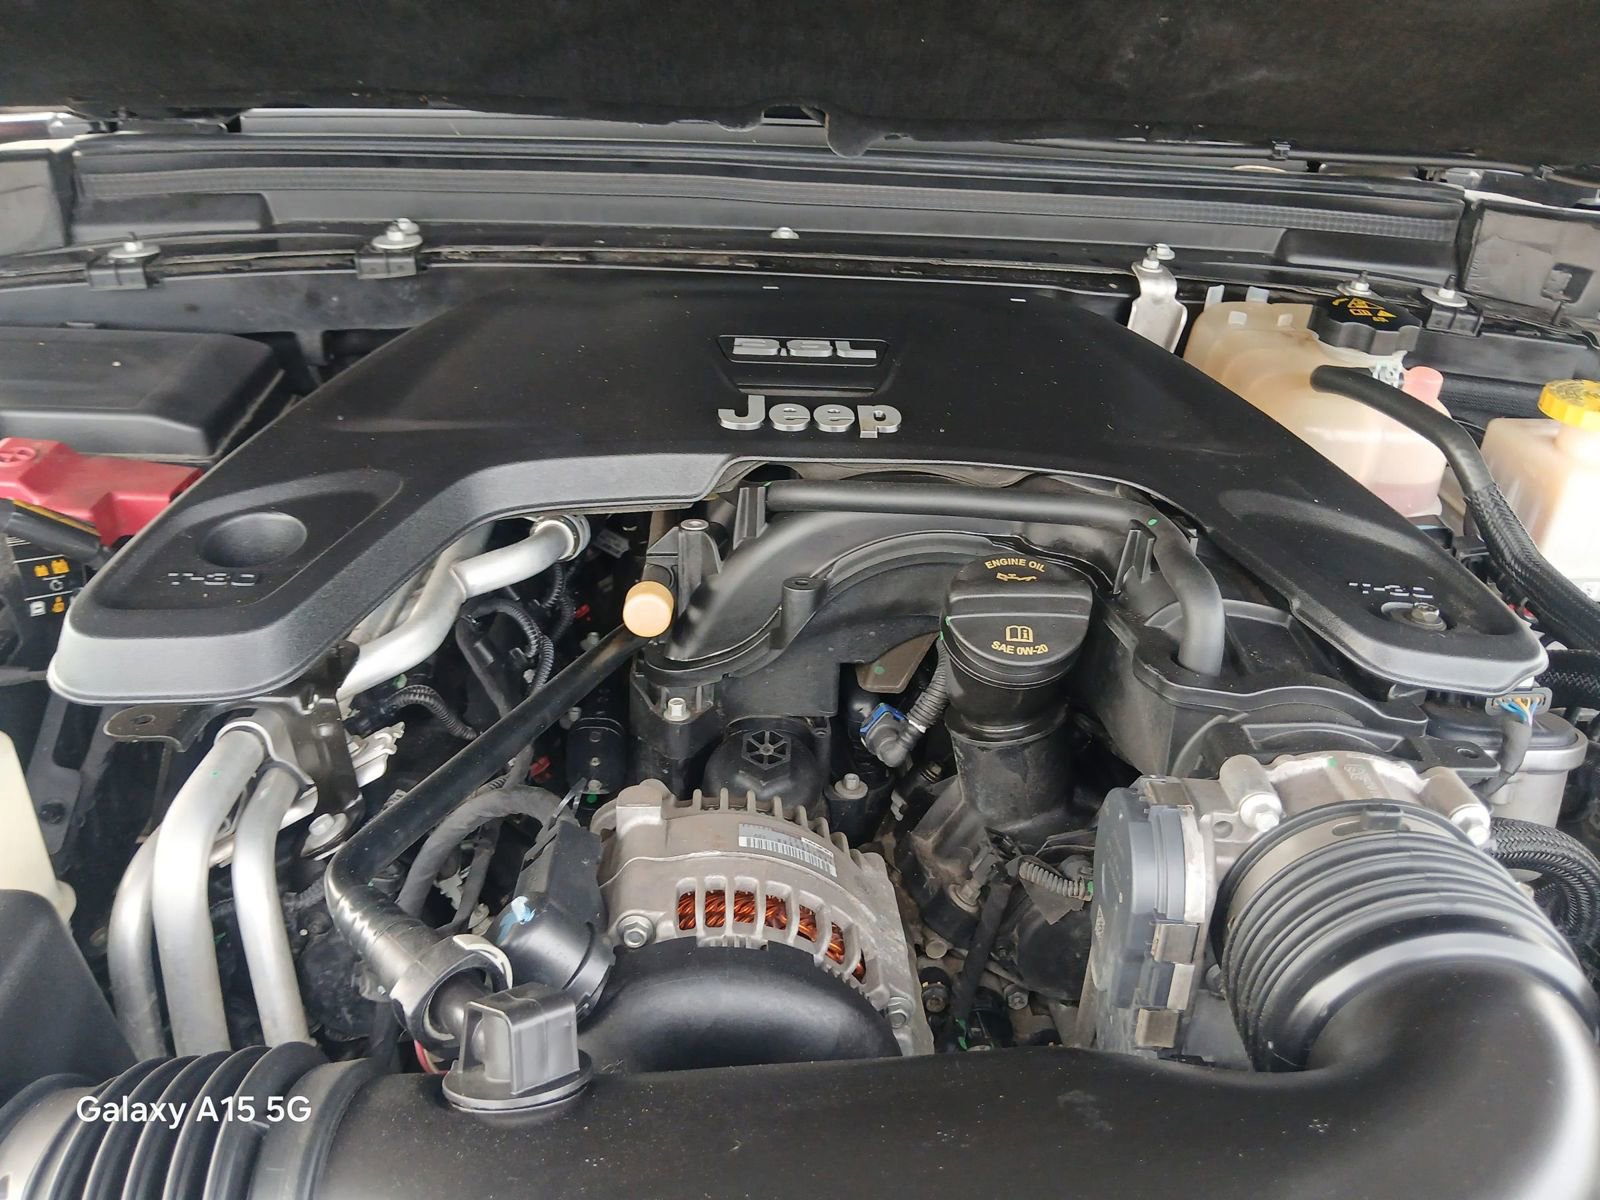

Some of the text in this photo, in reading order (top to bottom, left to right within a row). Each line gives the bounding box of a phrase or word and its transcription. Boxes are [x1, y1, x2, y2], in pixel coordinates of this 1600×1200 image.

[717, 394, 903, 439] Jeep
[984, 557, 1046, 573] ENGINE OIL
[991, 640, 1049, 656] SAE 0W-20
